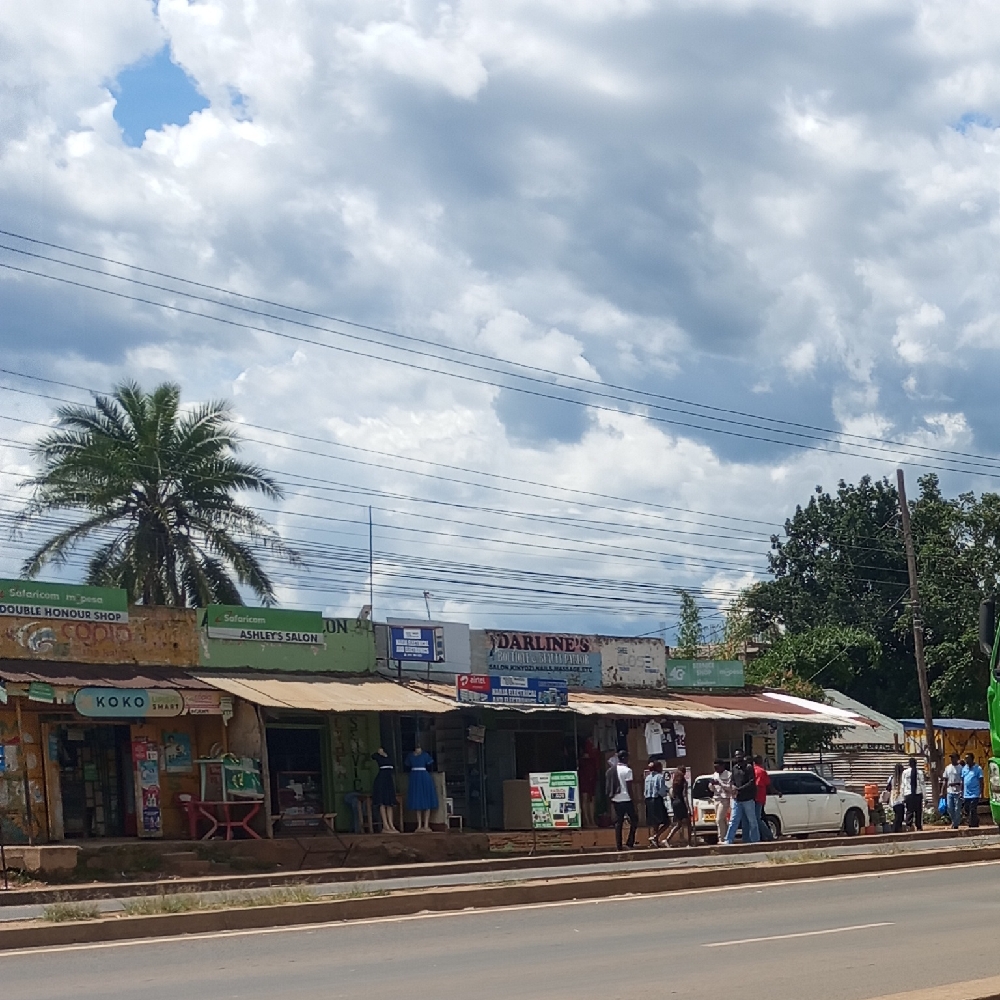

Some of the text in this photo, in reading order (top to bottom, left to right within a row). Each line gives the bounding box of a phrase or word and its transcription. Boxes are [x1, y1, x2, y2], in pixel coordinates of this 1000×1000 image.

[9, 588, 60, 600] Safaricom
[0, 605, 121, 621] DOUBLE HONOUR SHOP
[223, 614, 266, 624] Safaricom
[240, 630, 318, 643] ASHLEY'S SALON
[497, 634, 590, 652] DARLINE'S
[470, 676, 486, 684] airtel
[96, 696, 145, 708] KOKO
